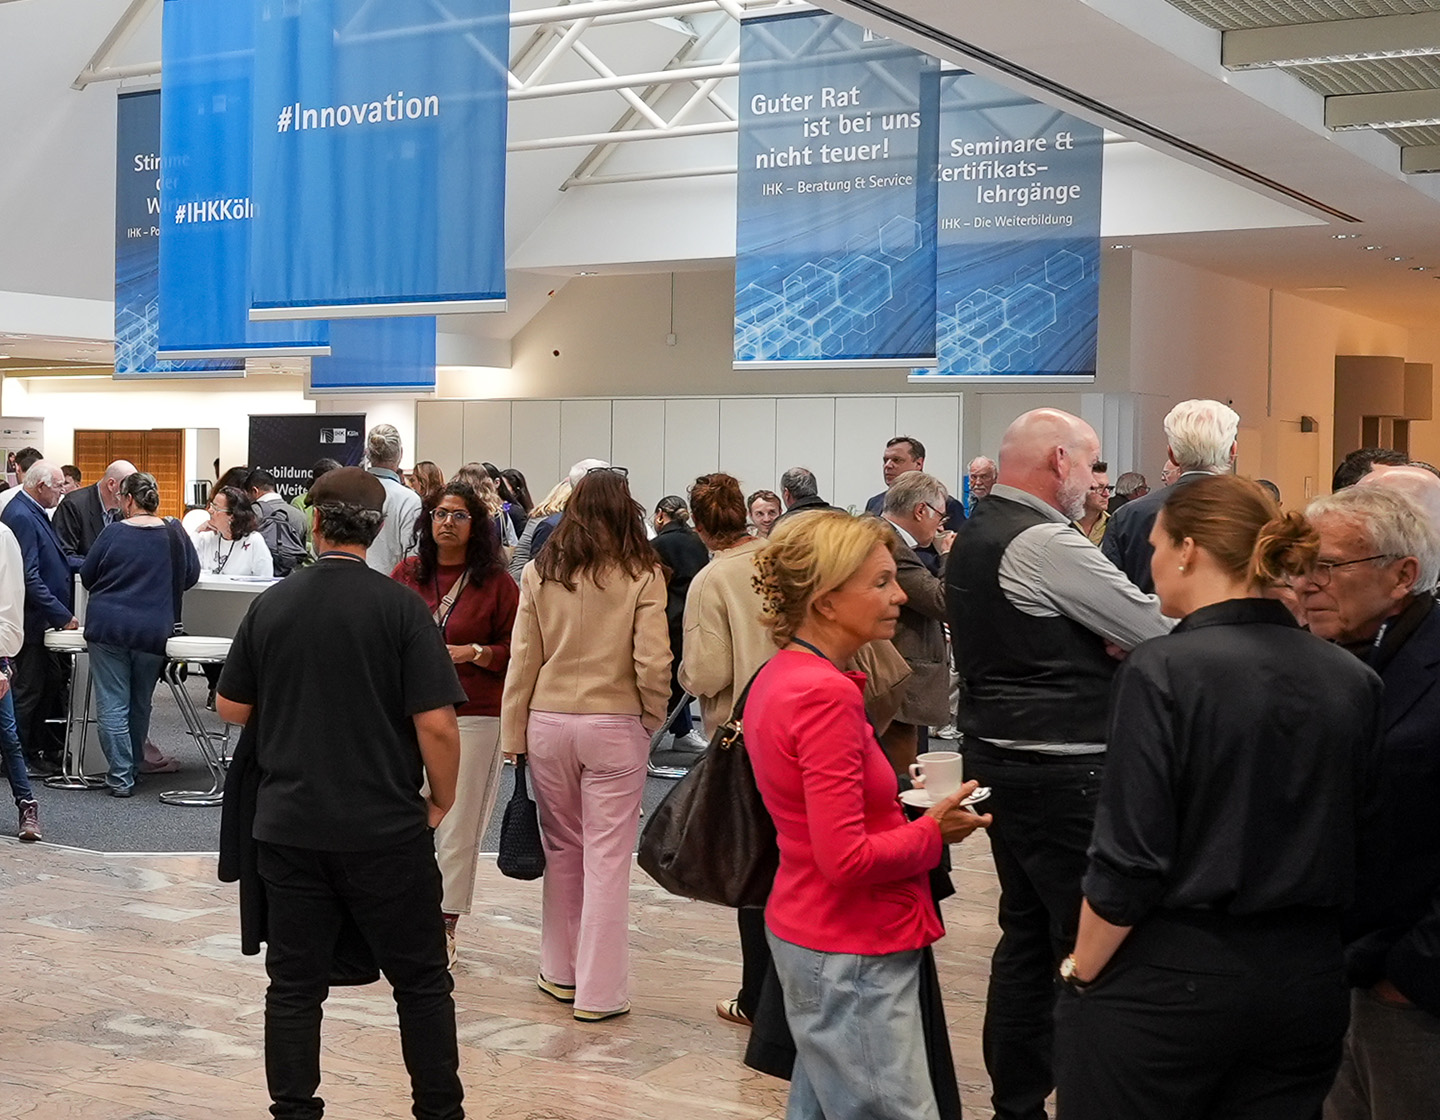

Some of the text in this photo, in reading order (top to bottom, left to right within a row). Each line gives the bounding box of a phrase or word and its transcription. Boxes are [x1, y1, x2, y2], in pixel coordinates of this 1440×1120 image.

[277, 90, 439, 133] #Innovation
[751, 85, 861, 116] Guter Rat
[803, 111, 921, 138] ist bei uns
[756, 137, 889, 169] nicht teuer!
[950, 131, 1074, 158] Seminare &
[762, 182, 783, 196] IHK
[797, 179, 851, 195] Beratung
[854, 176, 866, 189] &
[869, 173, 913, 188] Service
[977, 182, 1081, 207] lehrgänge
[127, 226, 142, 239] IHK
[941, 218, 961, 230] IHK
[974, 216, 992, 228] Die
[994, 213, 1073, 228] Weiterbildung
[276, 483, 309, 496] Weite
